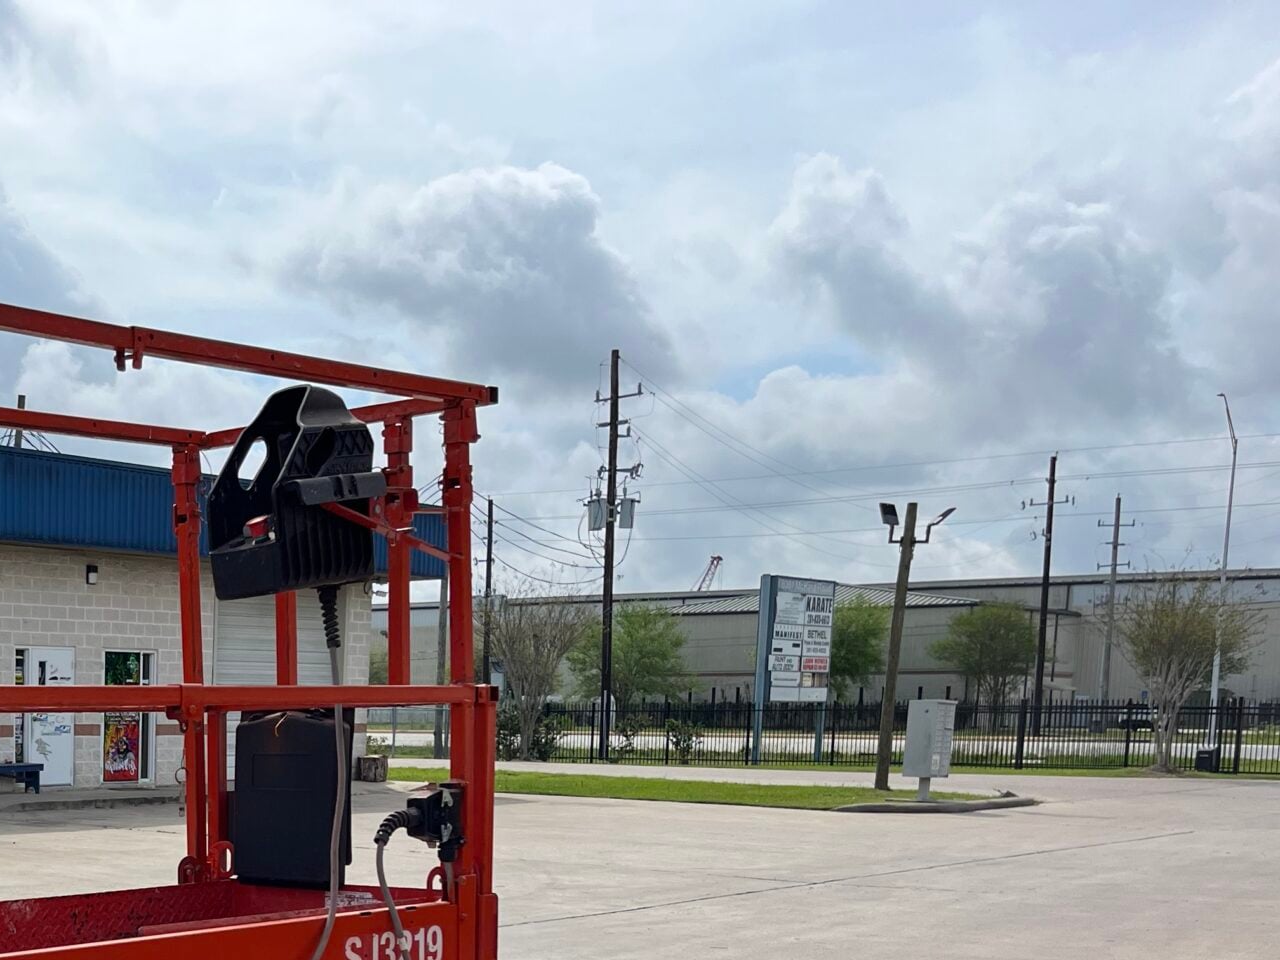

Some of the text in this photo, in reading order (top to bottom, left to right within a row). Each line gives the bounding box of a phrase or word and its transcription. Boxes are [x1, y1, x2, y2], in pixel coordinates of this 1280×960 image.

[806, 596, 832, 613] KARATE
[775, 630, 802, 639] MANIFEST
[807, 630, 827, 639] BETHEL
